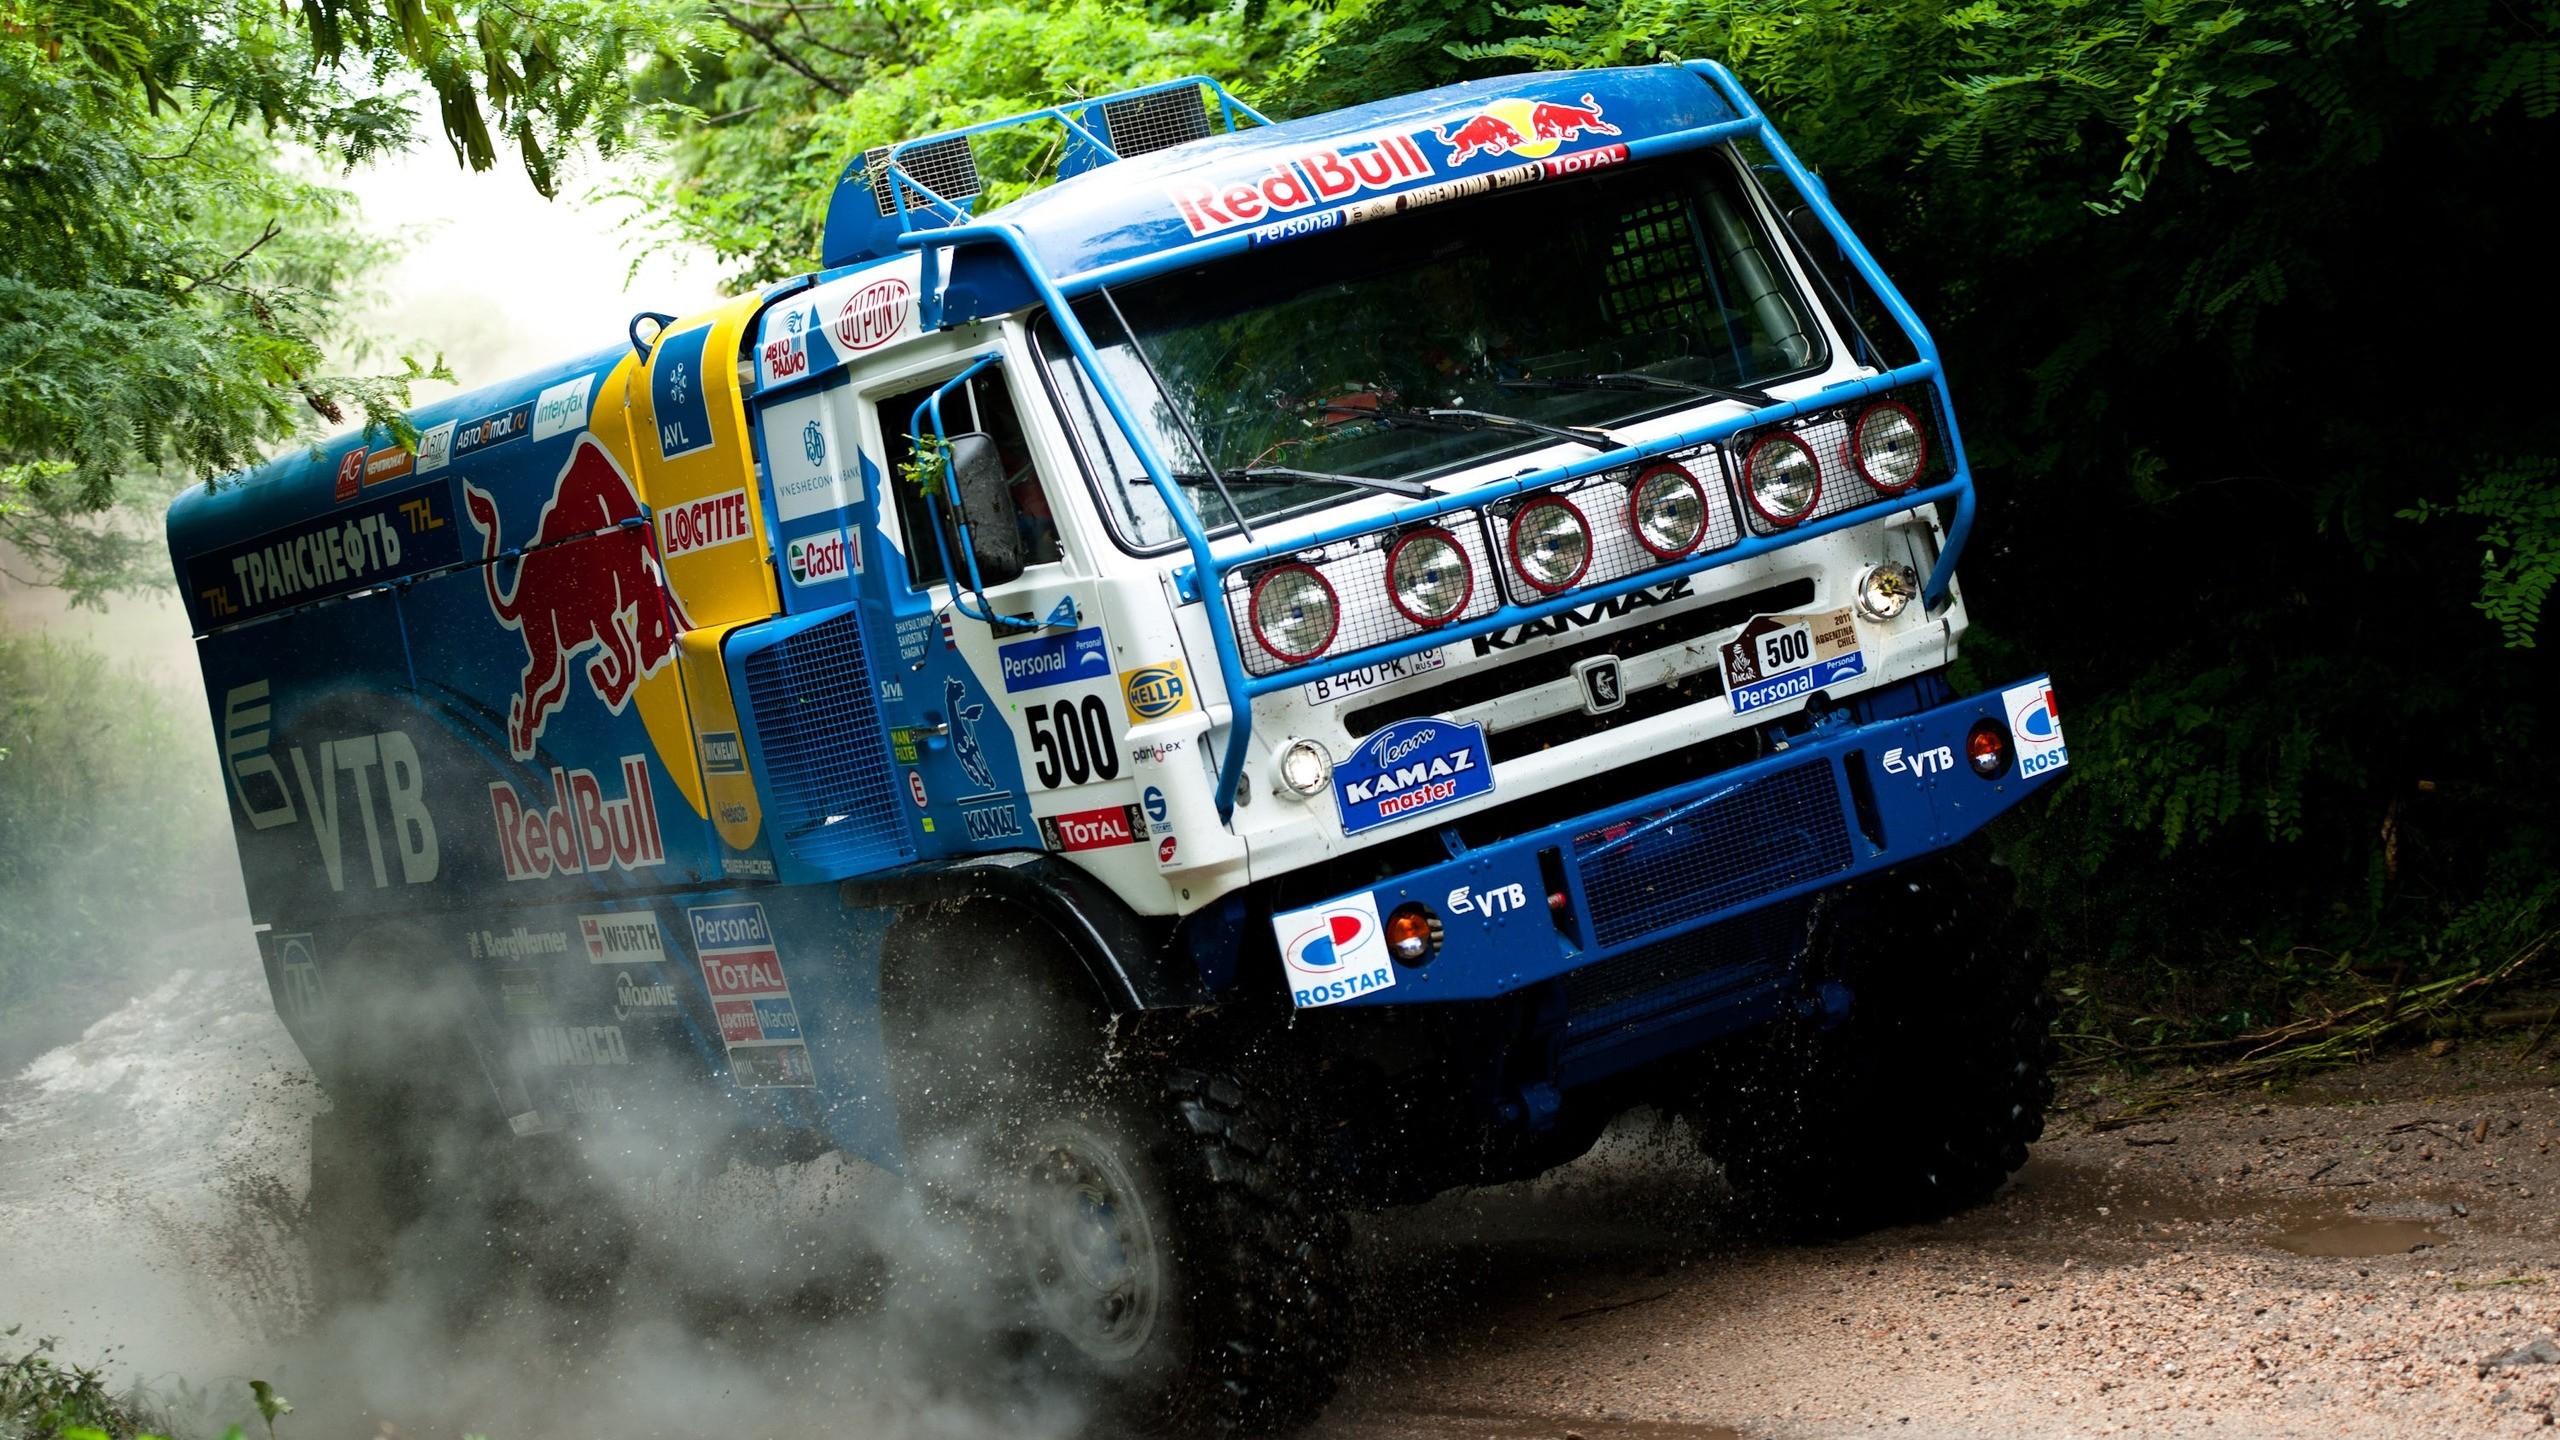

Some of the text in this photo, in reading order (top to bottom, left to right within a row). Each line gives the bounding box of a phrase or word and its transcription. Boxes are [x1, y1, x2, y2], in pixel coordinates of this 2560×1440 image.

[1551, 145, 1626, 176] TOTAL
[1175, 133, 1430, 233] Red Bull
[1406, 163, 1537, 209] ARGENTINA CHILE
[1255, 212, 1338, 244] Personal
[765, 338, 790, 363] АВТО
[772, 351, 806, 380] РАДИО
[663, 421, 689, 450] AVL
[779, 465, 861, 497] VNESHECONBANK
[663, 491, 748, 555] LOCTITE
[231, 512, 401, 607] ТРАНСНЕФТЬ
[806, 532, 862, 580] Castrol
[1815, 625, 1855, 646] ARGENTINA
[1834, 613, 1852, 626] 2011
[1076, 635, 1102, 651] Personal
[1765, 629, 1810, 669] 500
[1837, 637, 1857, 649] CHILE
[1003, 644, 1067, 680] Personal
[1415, 660, 1433, 672] RUS
[1826, 655, 1856, 671] Personal
[1130, 677, 1184, 705] HELLA
[1738, 667, 1815, 711] Personal
[705, 741, 740, 761] MICHELIN
[1024, 694, 1120, 790] 500
[1371, 726, 1436, 770] Team
[1345, 746, 1475, 806] KAMAZ
[1907, 745, 1955, 778] VTB
[289, 729, 441, 893] VTB
[1379, 778, 1458, 819] master
[490, 760, 663, 877] Red Bull
[962, 804, 1023, 842] KAMAZ
[1058, 817, 1130, 845] TOTAL
[1475, 882, 1527, 918] VTB
[602, 923, 661, 952] WÜRTH
[695, 907, 766, 946] Personal
[481, 927, 568, 961] BorgWarner
[705, 958, 783, 991] TOTAL
[1295, 967, 1390, 1008] ROSTAR
[617, 985, 679, 1007] MODINE
[721, 1004, 797, 1029] LOCTITE Macro
[529, 1024, 630, 1066] WABCO
